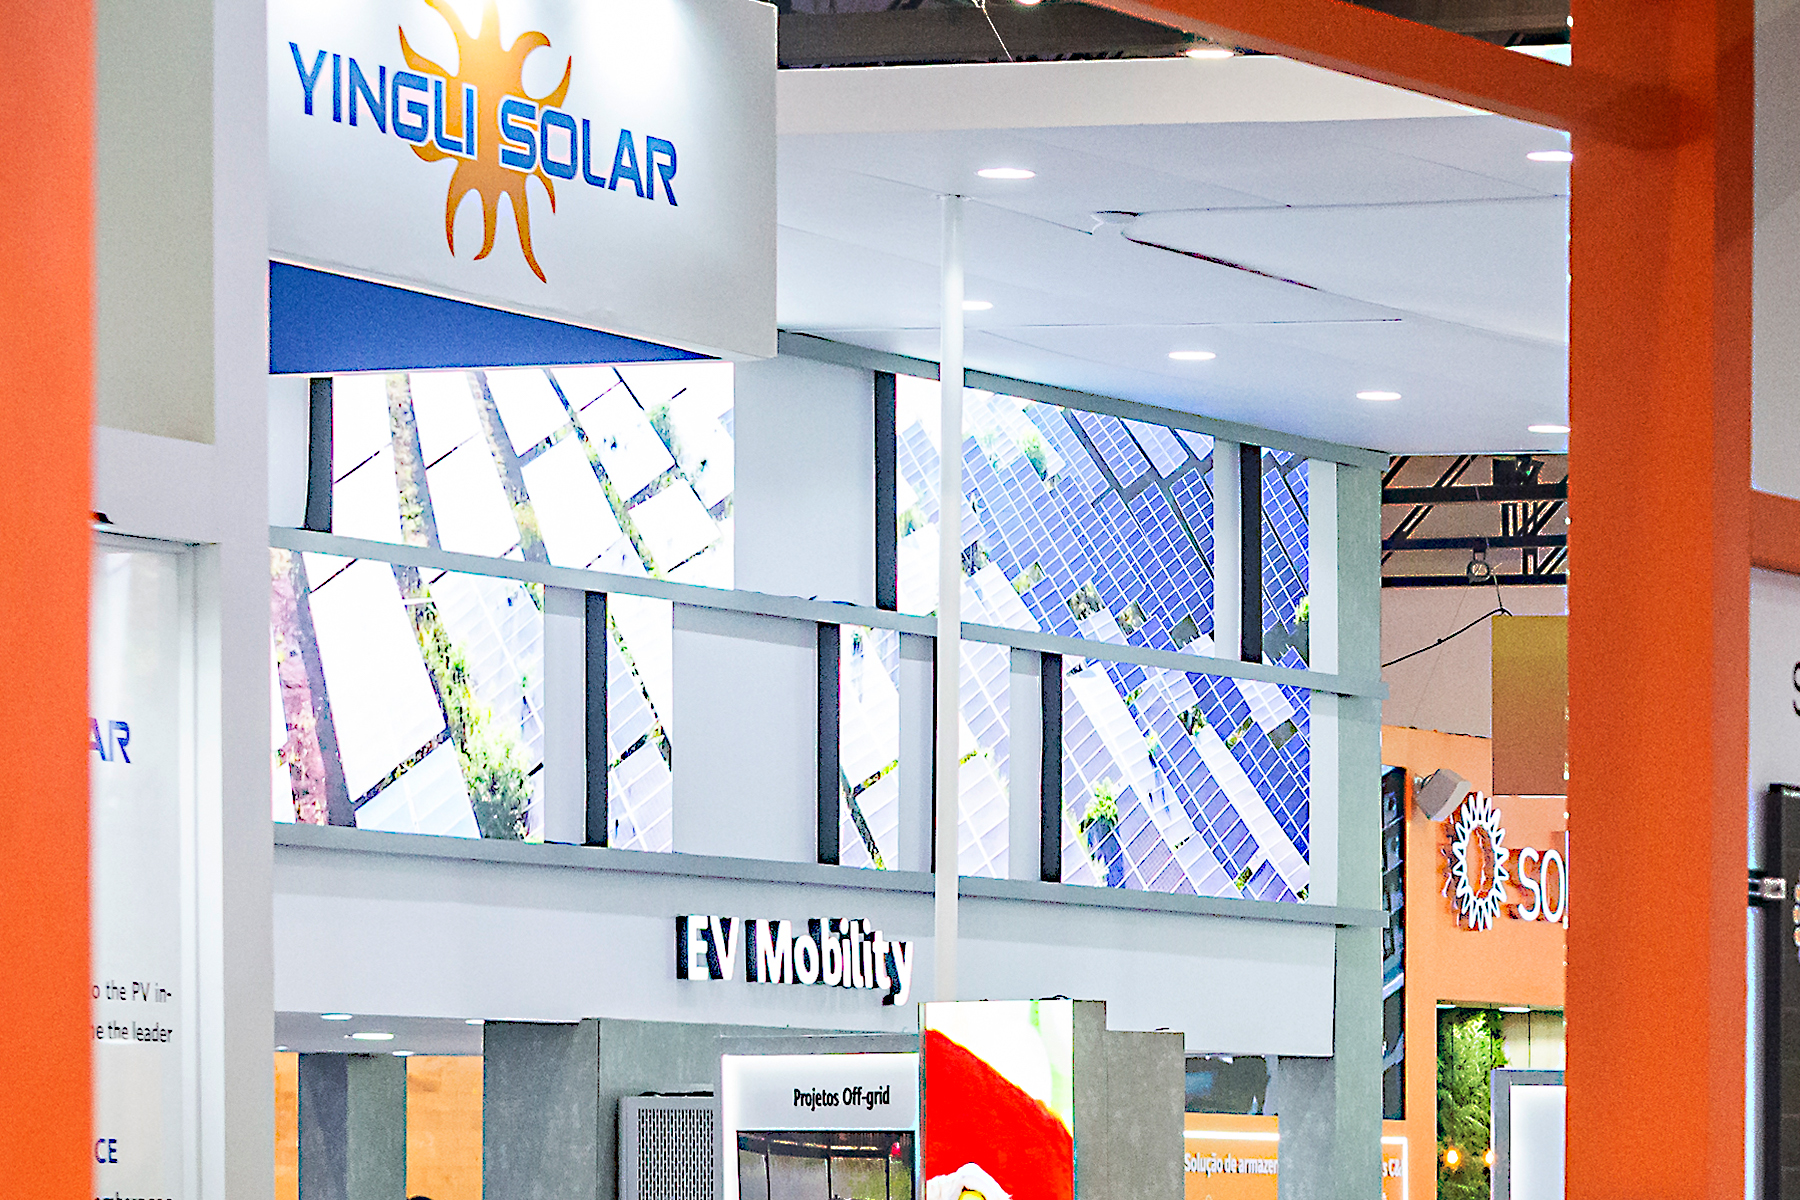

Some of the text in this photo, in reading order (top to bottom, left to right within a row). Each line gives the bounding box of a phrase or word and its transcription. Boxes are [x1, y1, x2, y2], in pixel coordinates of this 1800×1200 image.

[289, 41, 680, 207] YINGLI SOLAR
[679, 915, 914, 1006] EV Mobility
[105, 980, 126, 1000] the
[132, 981, 150, 1001] PV
[155, 982, 172, 1003] in-
[107, 1020, 128, 1040] the
[132, 1020, 173, 1043] leader
[793, 1084, 890, 1112] Projetos Off-grid
[95, 1138, 118, 1164] CE
[1185, 1152, 1223, 1178] Solução
[1224, 1153, 1237, 1173] de
